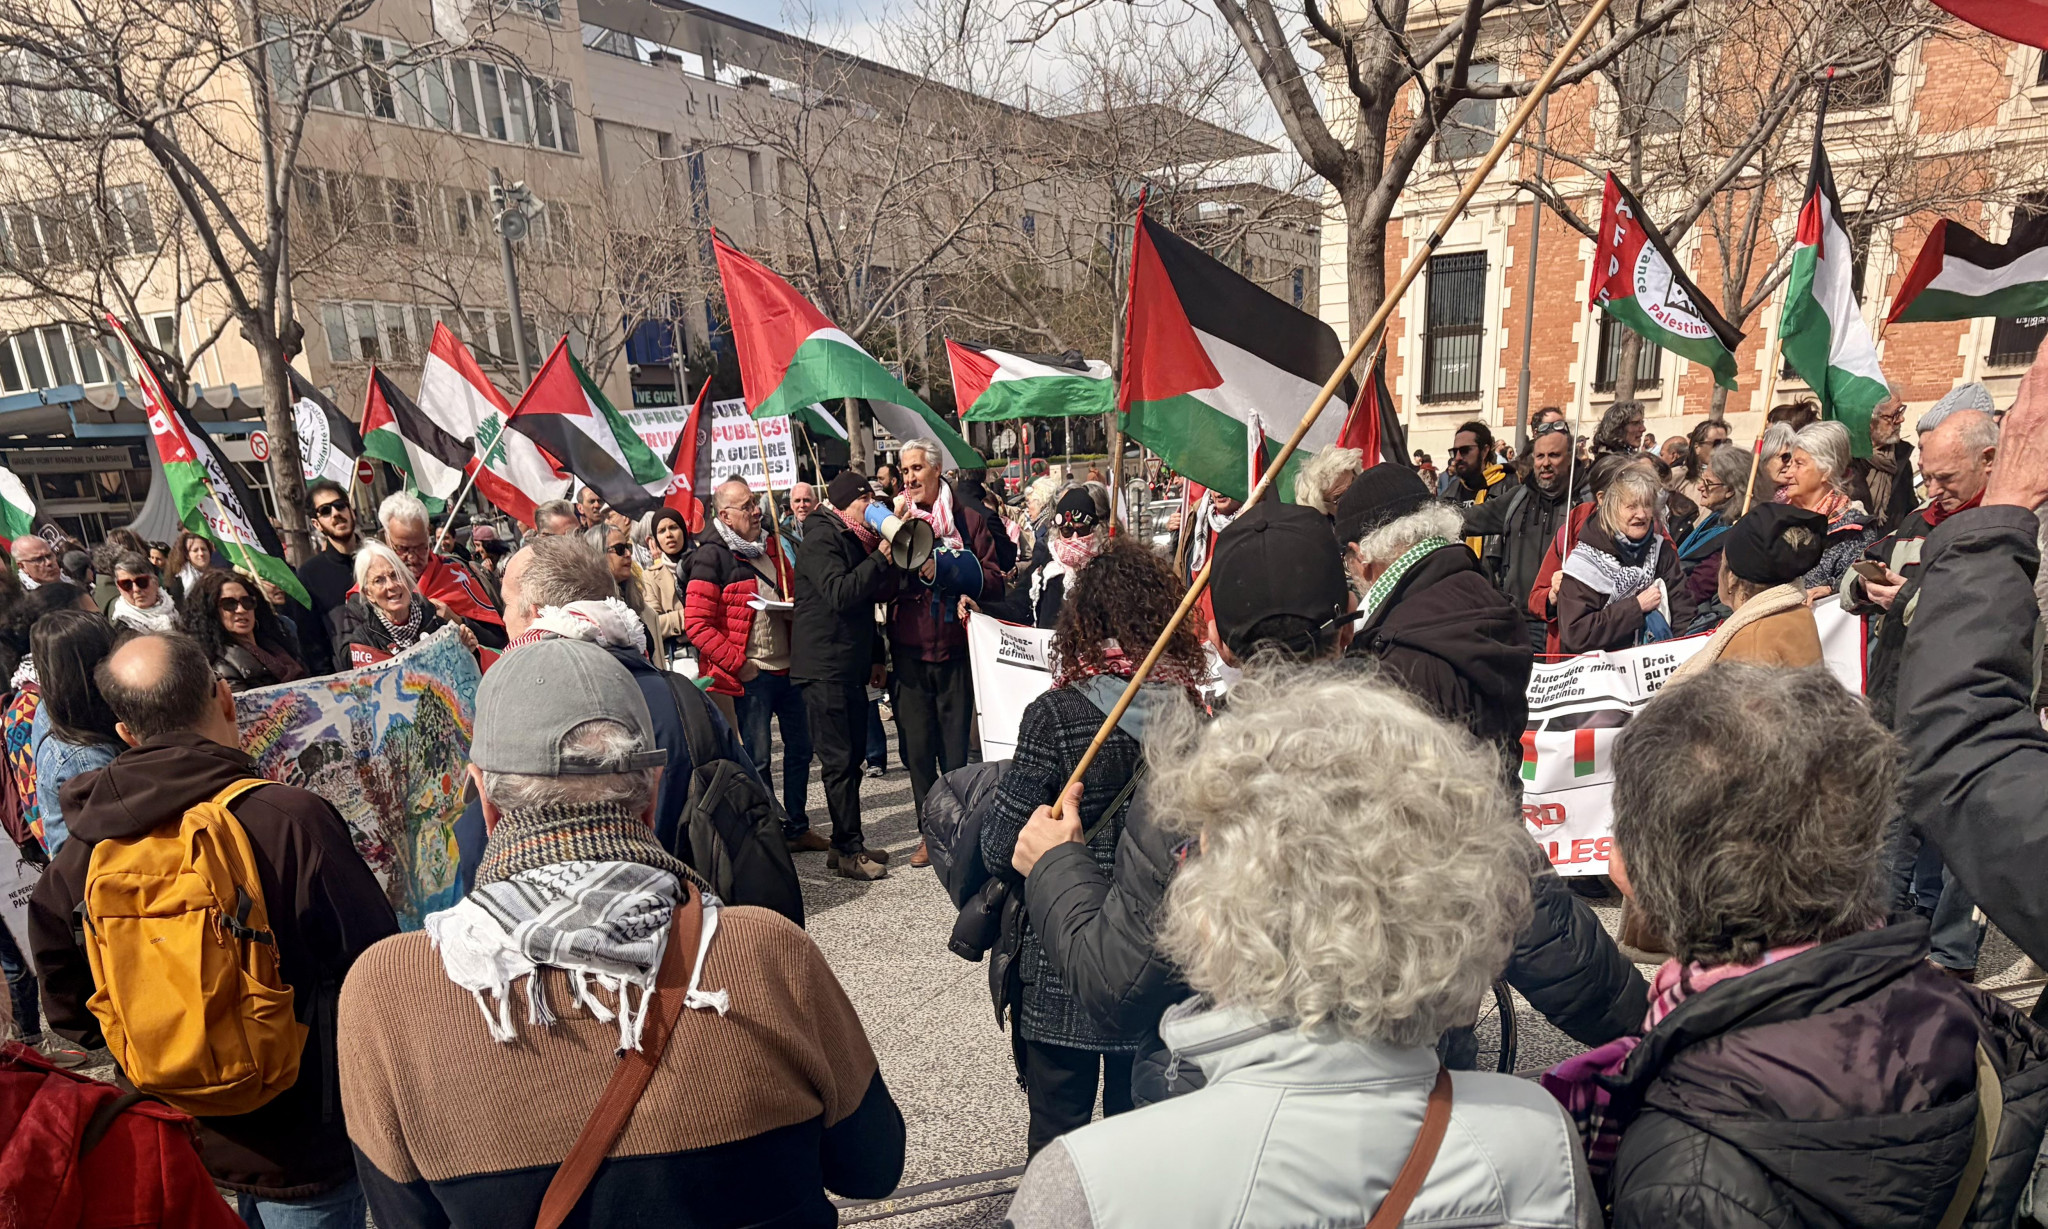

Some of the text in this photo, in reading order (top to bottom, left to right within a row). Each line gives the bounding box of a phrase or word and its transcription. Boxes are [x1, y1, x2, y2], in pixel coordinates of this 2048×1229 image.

[1637, 246, 1655, 294] rance
[1647, 303, 1709, 335] Palestine
[642, 409, 685, 425] FRIC
[712, 417, 789, 443] PUBLCS!
[314, 432, 328, 473] Solidarité
[998, 647, 1035, 662] définitif
[1642, 653, 1676, 669] Droit
[1645, 662, 1682, 681] au re
[1530, 676, 1579, 696] du peuple
[1527, 687, 1586, 705] palestinien
[352, 727, 374, 746] SOS
[1522, 802, 1567, 831] RD
[1538, 836, 1614, 866] LES
[8, 882, 36, 900] NE PERD
